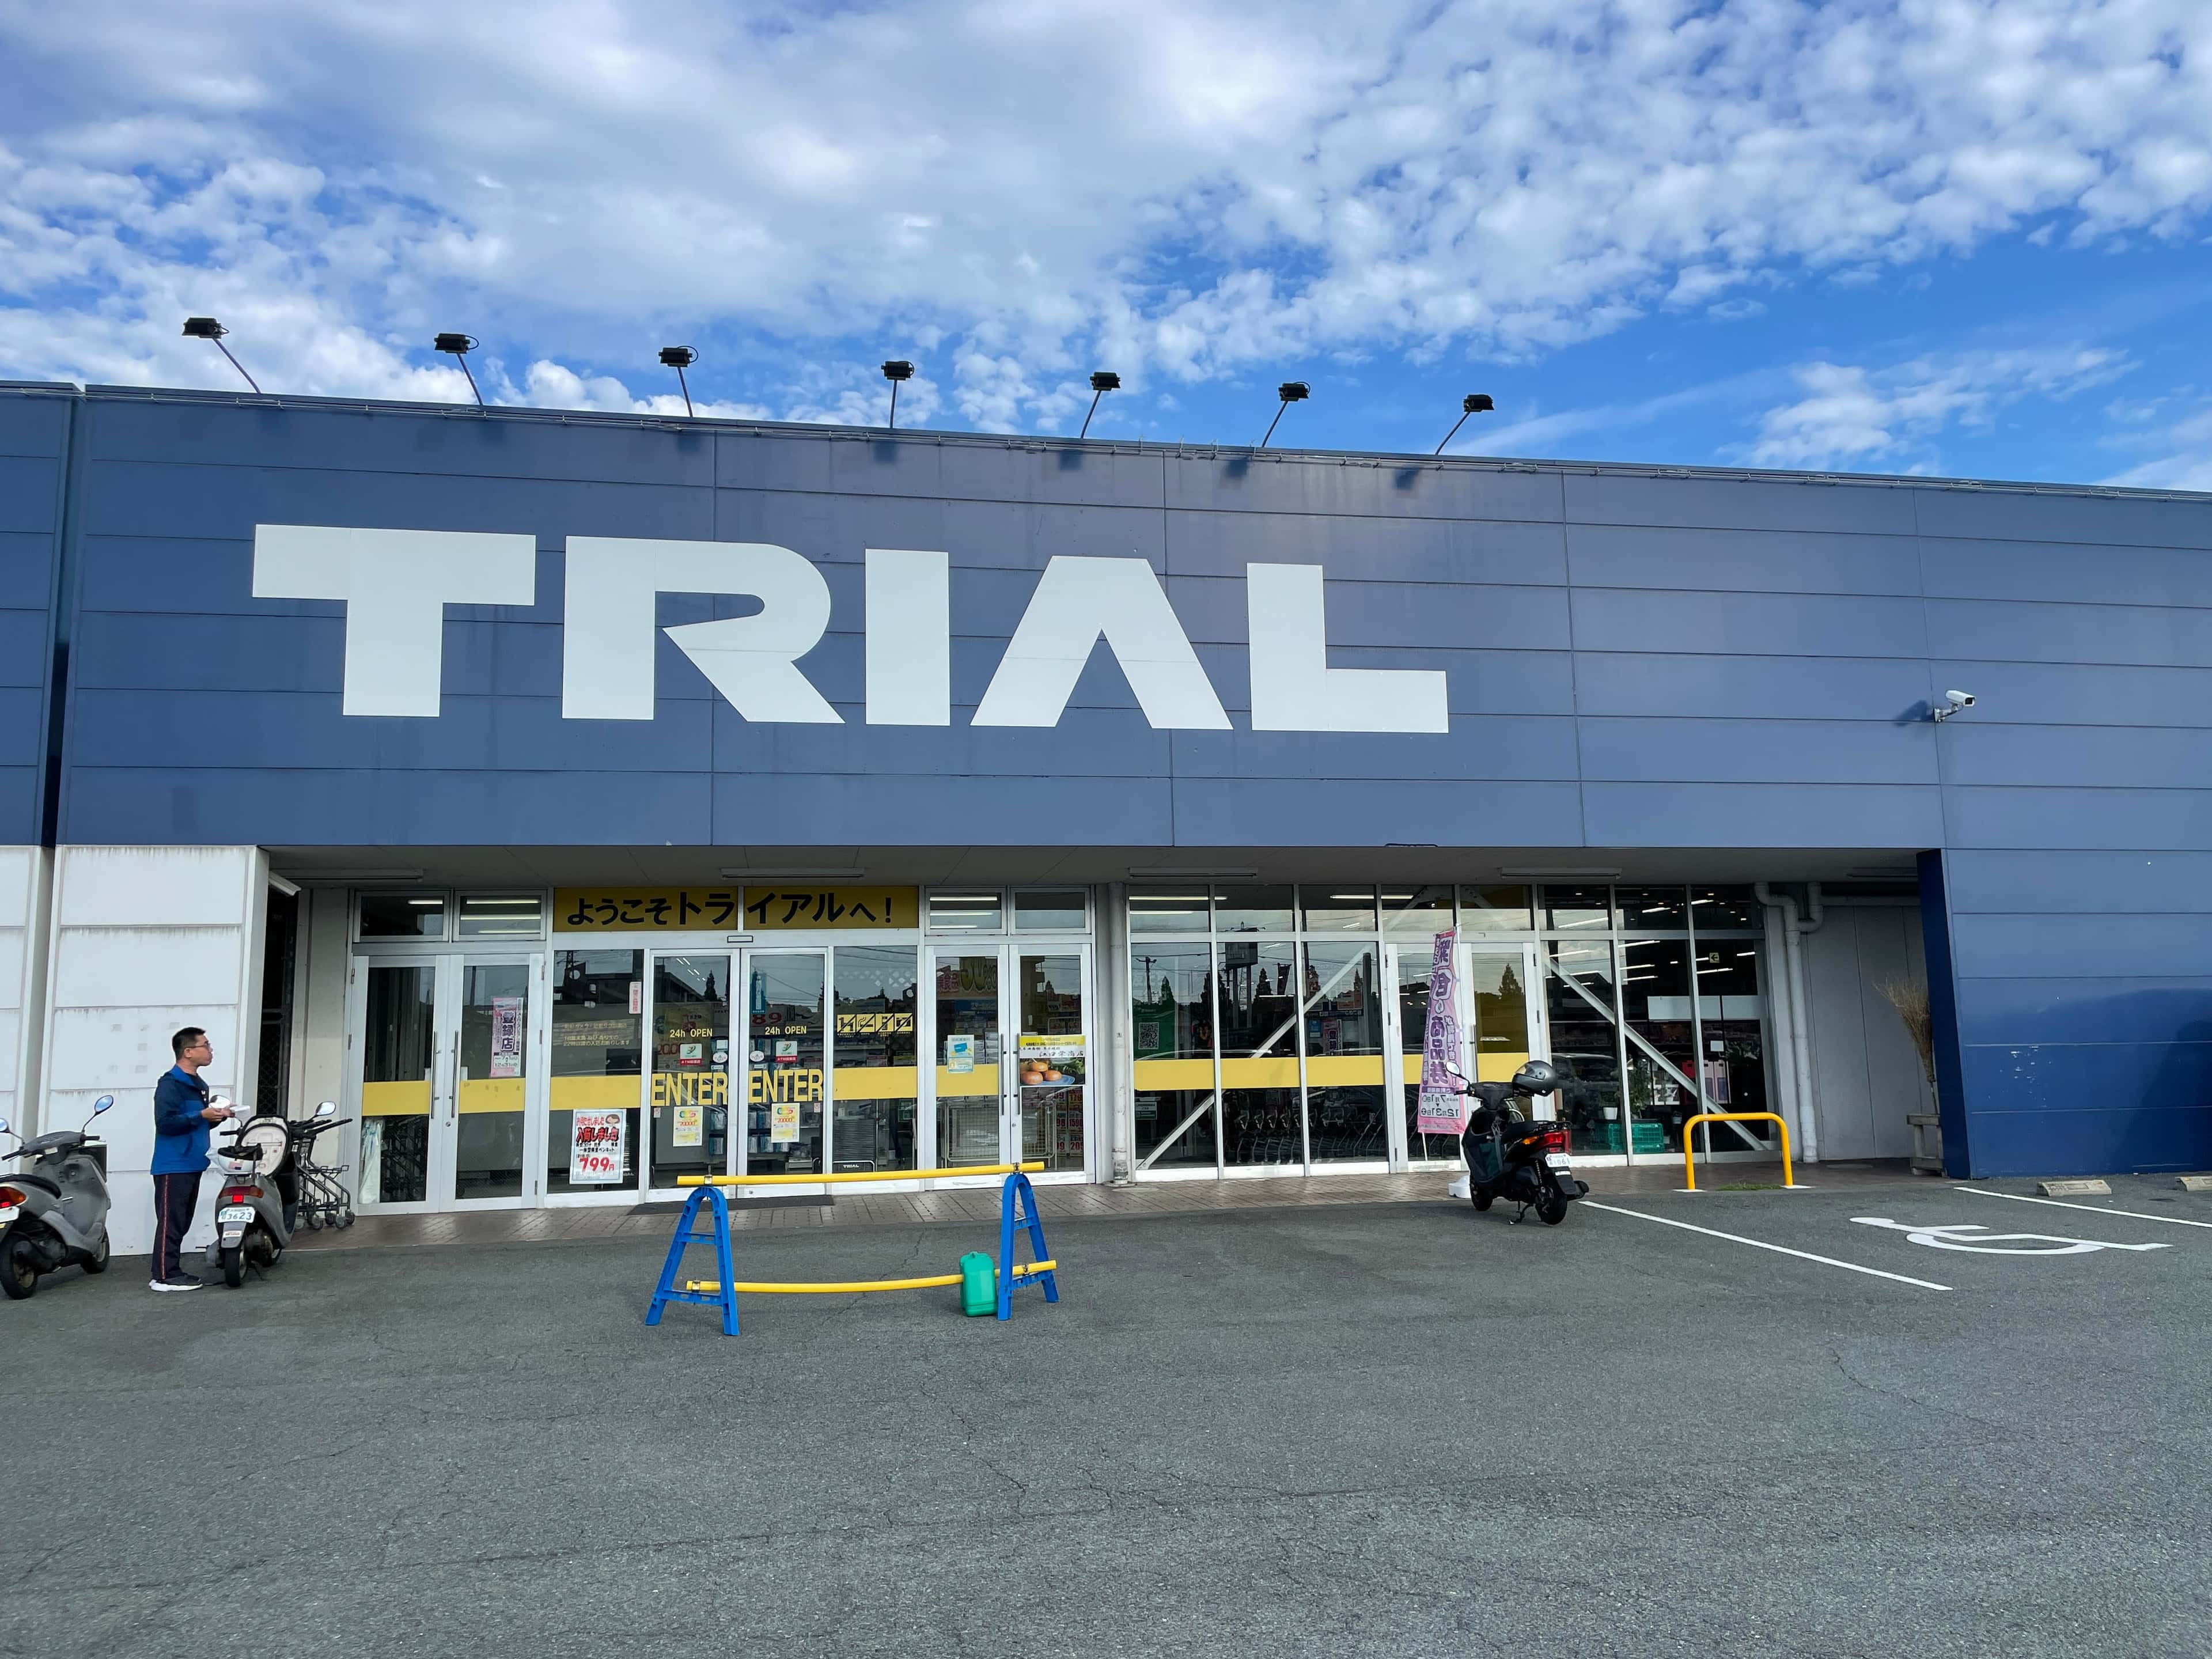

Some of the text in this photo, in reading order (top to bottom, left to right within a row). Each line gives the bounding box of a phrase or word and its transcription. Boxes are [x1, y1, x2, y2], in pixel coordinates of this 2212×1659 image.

[252, 524, 1449, 734] TRIAL
[567, 891, 892, 925] ようこそトライアルへ！
[670, 1028, 713, 1037] 24h OPEN
[765, 1026, 806, 1035] 24h OPEN
[650, 1072, 728, 1107] ENTER
[748, 1069, 824, 1103] ENTER
[576, 1126, 619, 1143] 入荷しました
[579, 1157, 614, 1172] 799円
